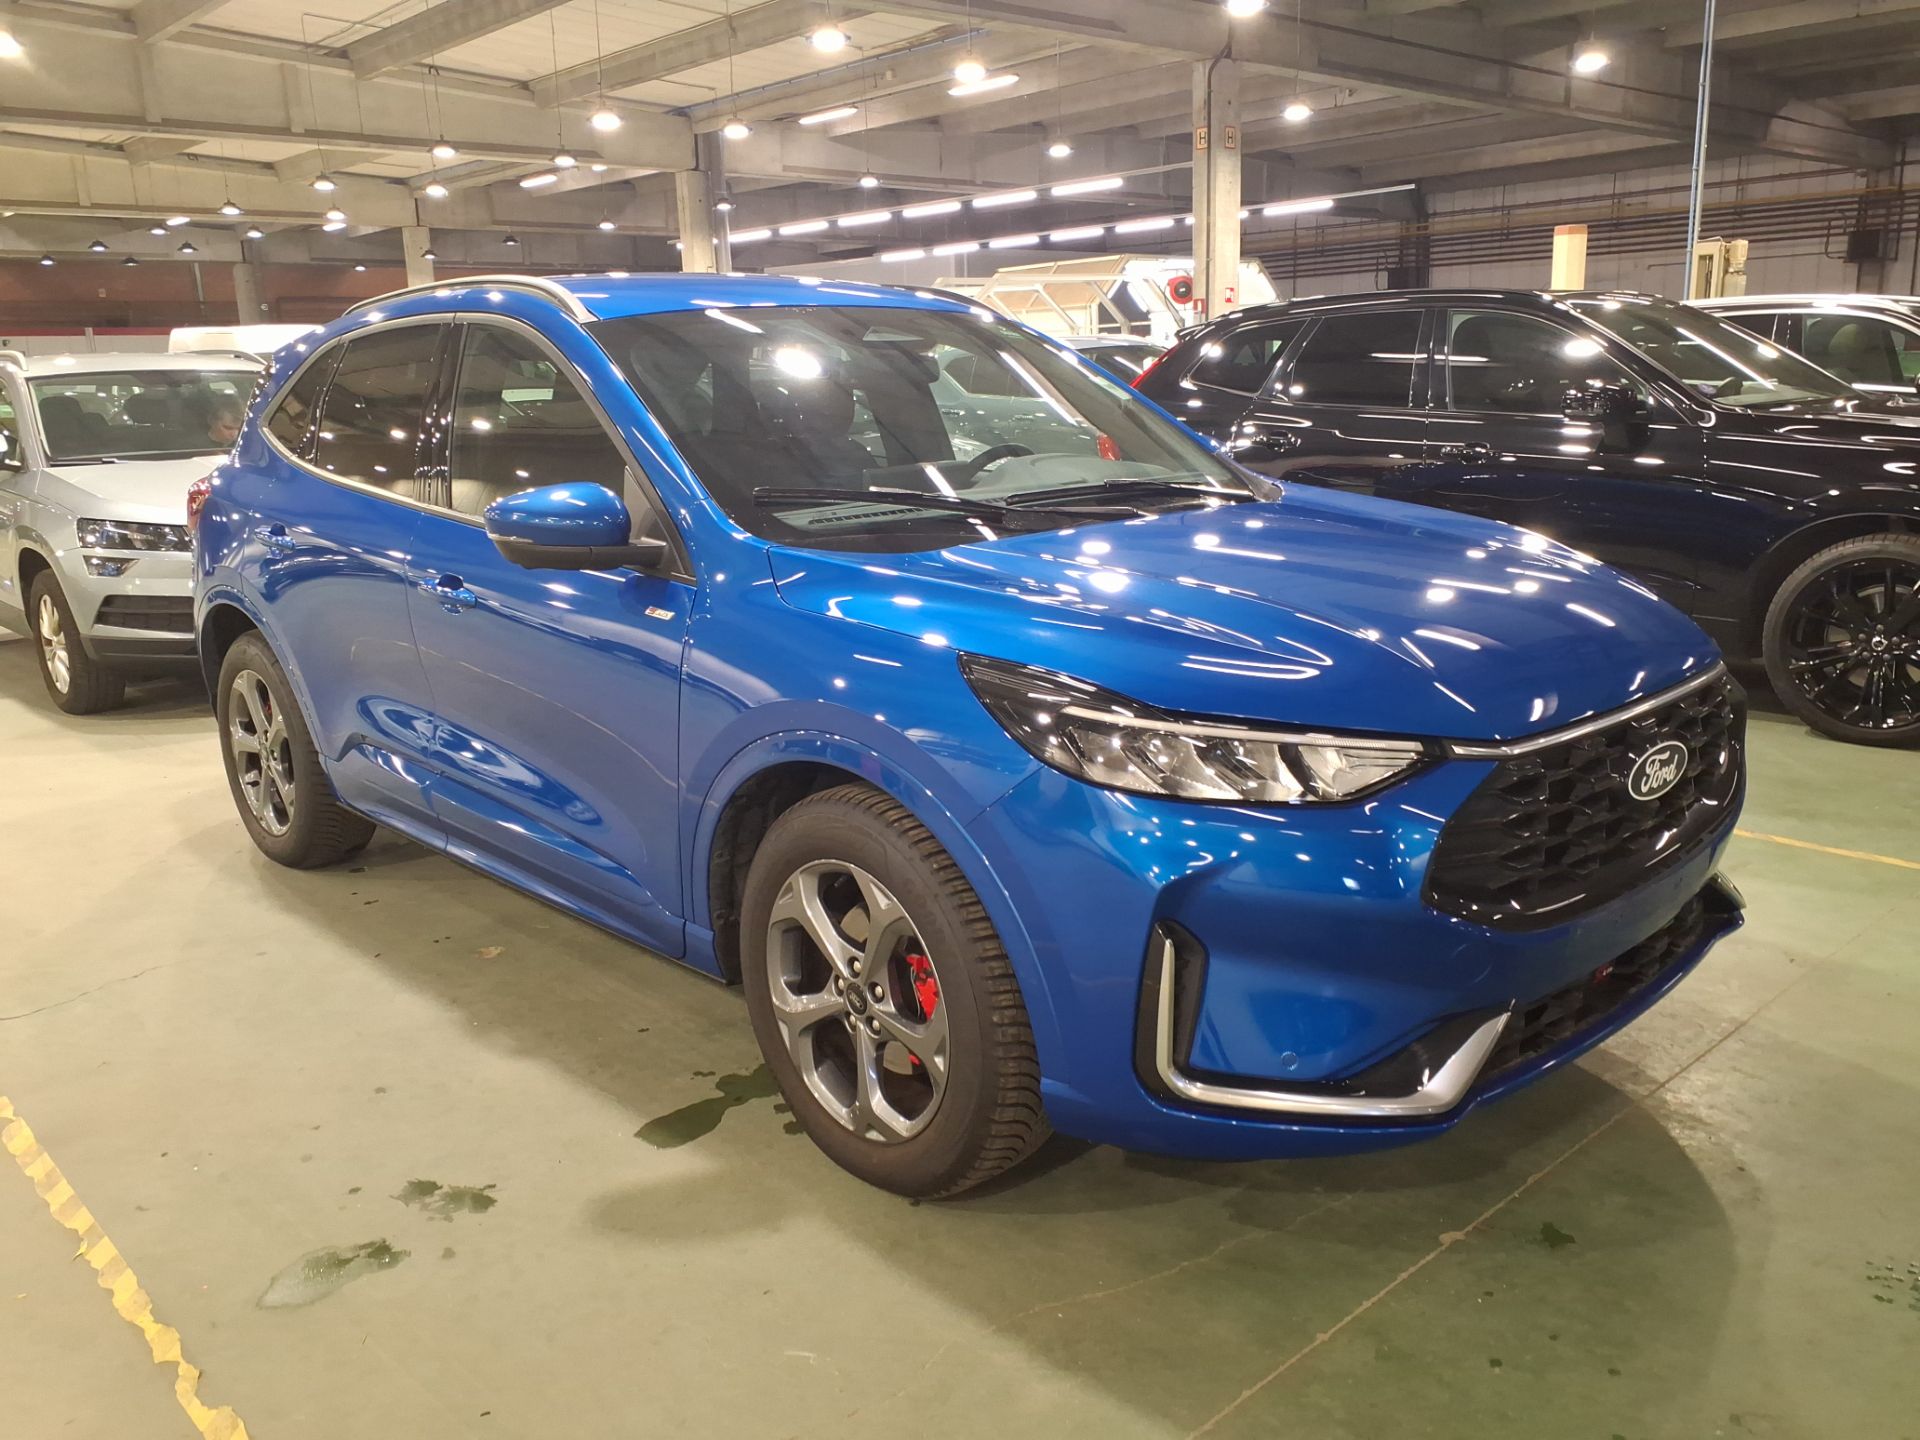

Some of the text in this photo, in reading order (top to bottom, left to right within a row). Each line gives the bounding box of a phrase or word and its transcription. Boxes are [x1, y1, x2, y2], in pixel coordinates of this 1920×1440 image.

[1199, 130, 1207, 145] H
[1227, 130, 1234, 144] H
[1641, 750, 1678, 793] Ford
